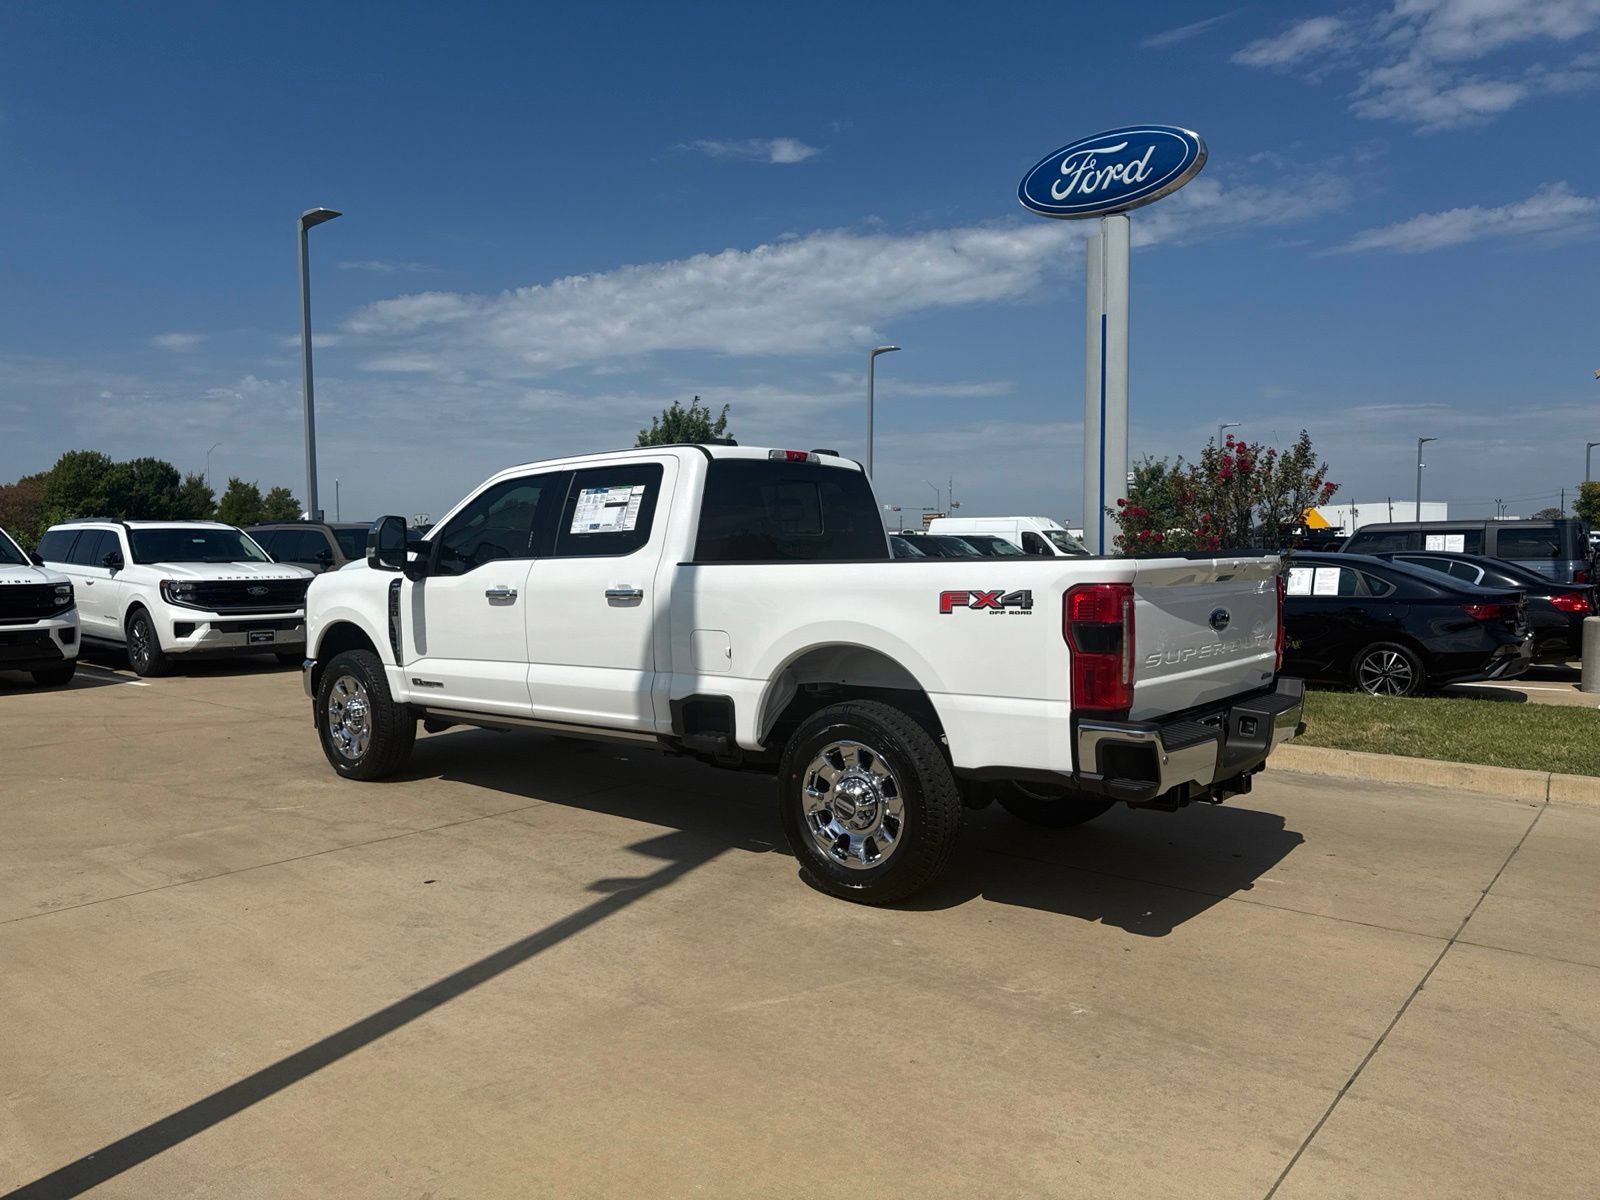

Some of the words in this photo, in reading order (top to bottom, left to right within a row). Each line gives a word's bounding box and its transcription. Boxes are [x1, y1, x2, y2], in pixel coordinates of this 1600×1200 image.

[1051, 141, 1156, 201] Ford
[939, 589, 1034, 614] FX4
[1145, 642, 1227, 669] SUPER
